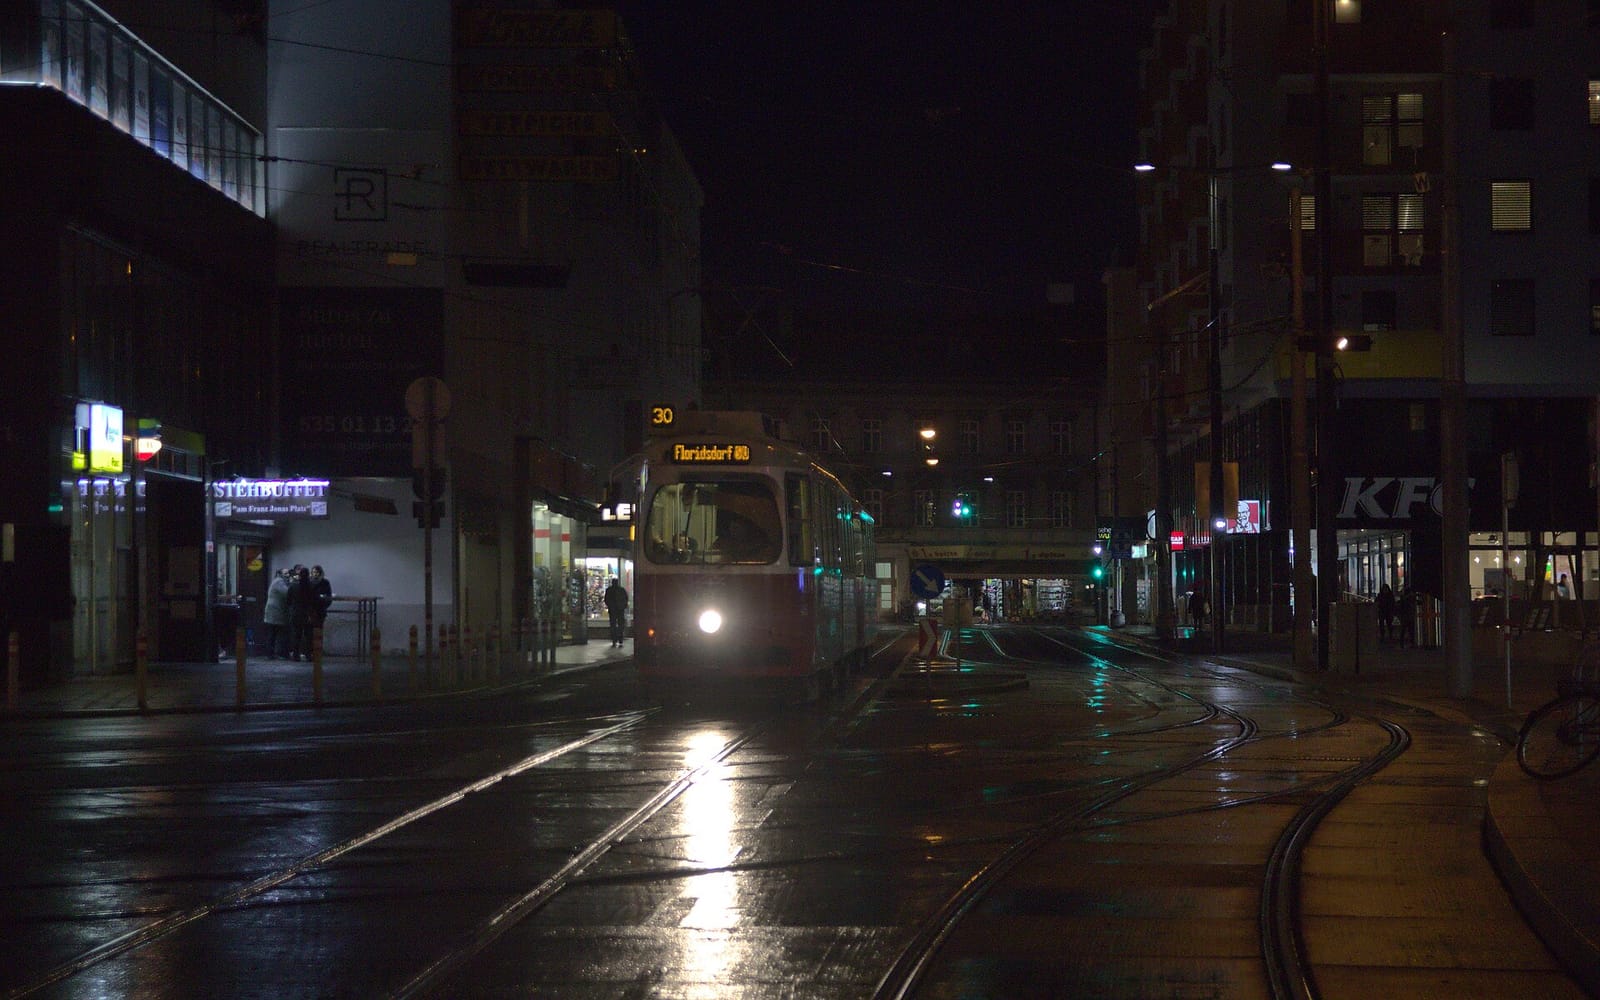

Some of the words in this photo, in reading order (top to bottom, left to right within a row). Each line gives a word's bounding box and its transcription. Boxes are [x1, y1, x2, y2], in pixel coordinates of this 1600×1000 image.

[652, 407, 673, 424] 30
[342, 416, 365, 433] 01
[372, 416, 396, 433] 13
[675, 444, 734, 461] Floridsdorf
[213, 482, 325, 498] STEHBUFFET
[269, 505, 289, 513] Jonas
[602, 503, 636, 521] LE
